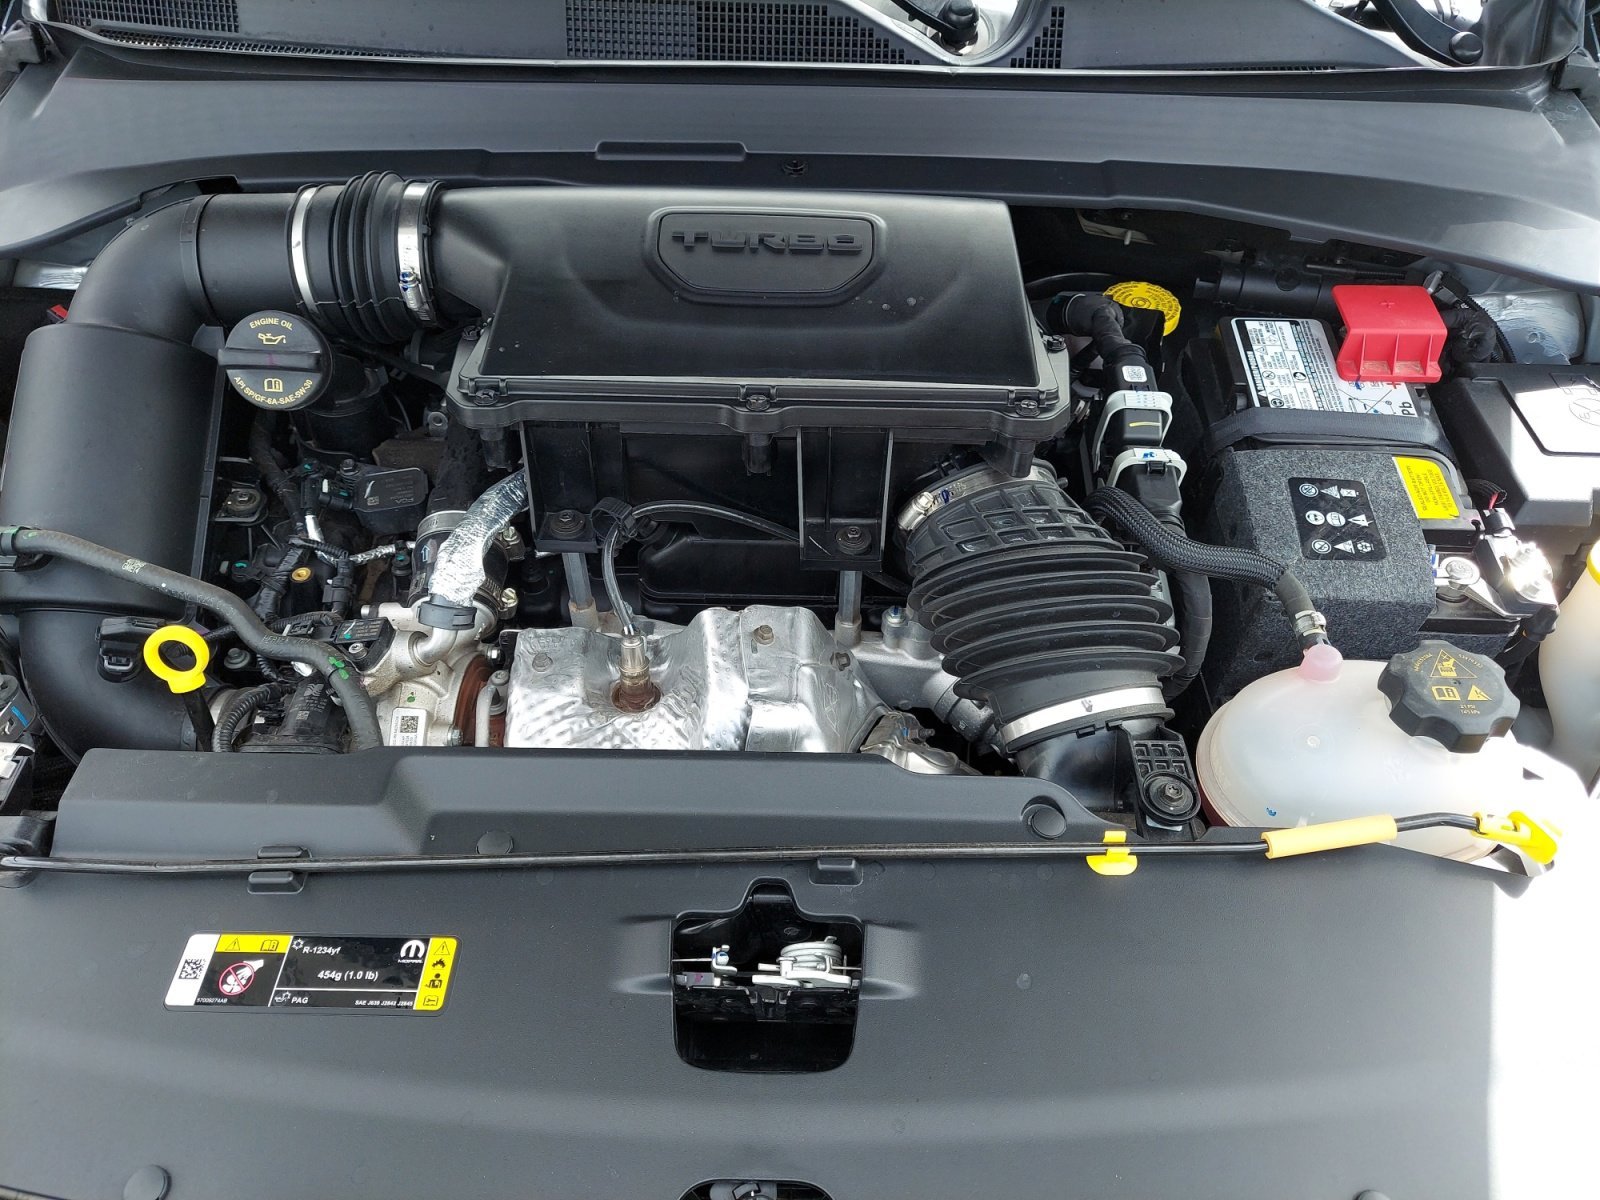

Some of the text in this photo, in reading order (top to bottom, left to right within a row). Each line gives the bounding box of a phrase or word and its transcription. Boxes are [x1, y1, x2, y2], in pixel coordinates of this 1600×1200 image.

[671, 230, 863, 254] TURBO
[249, 317, 294, 331] ENGINE OIL
[233, 377, 245, 389] API
[1399, 401, 1416, 416] Pb
[302, 946, 341, 956] R-1234yf
[317, 970, 379, 981] 454g (1.0 lb)
